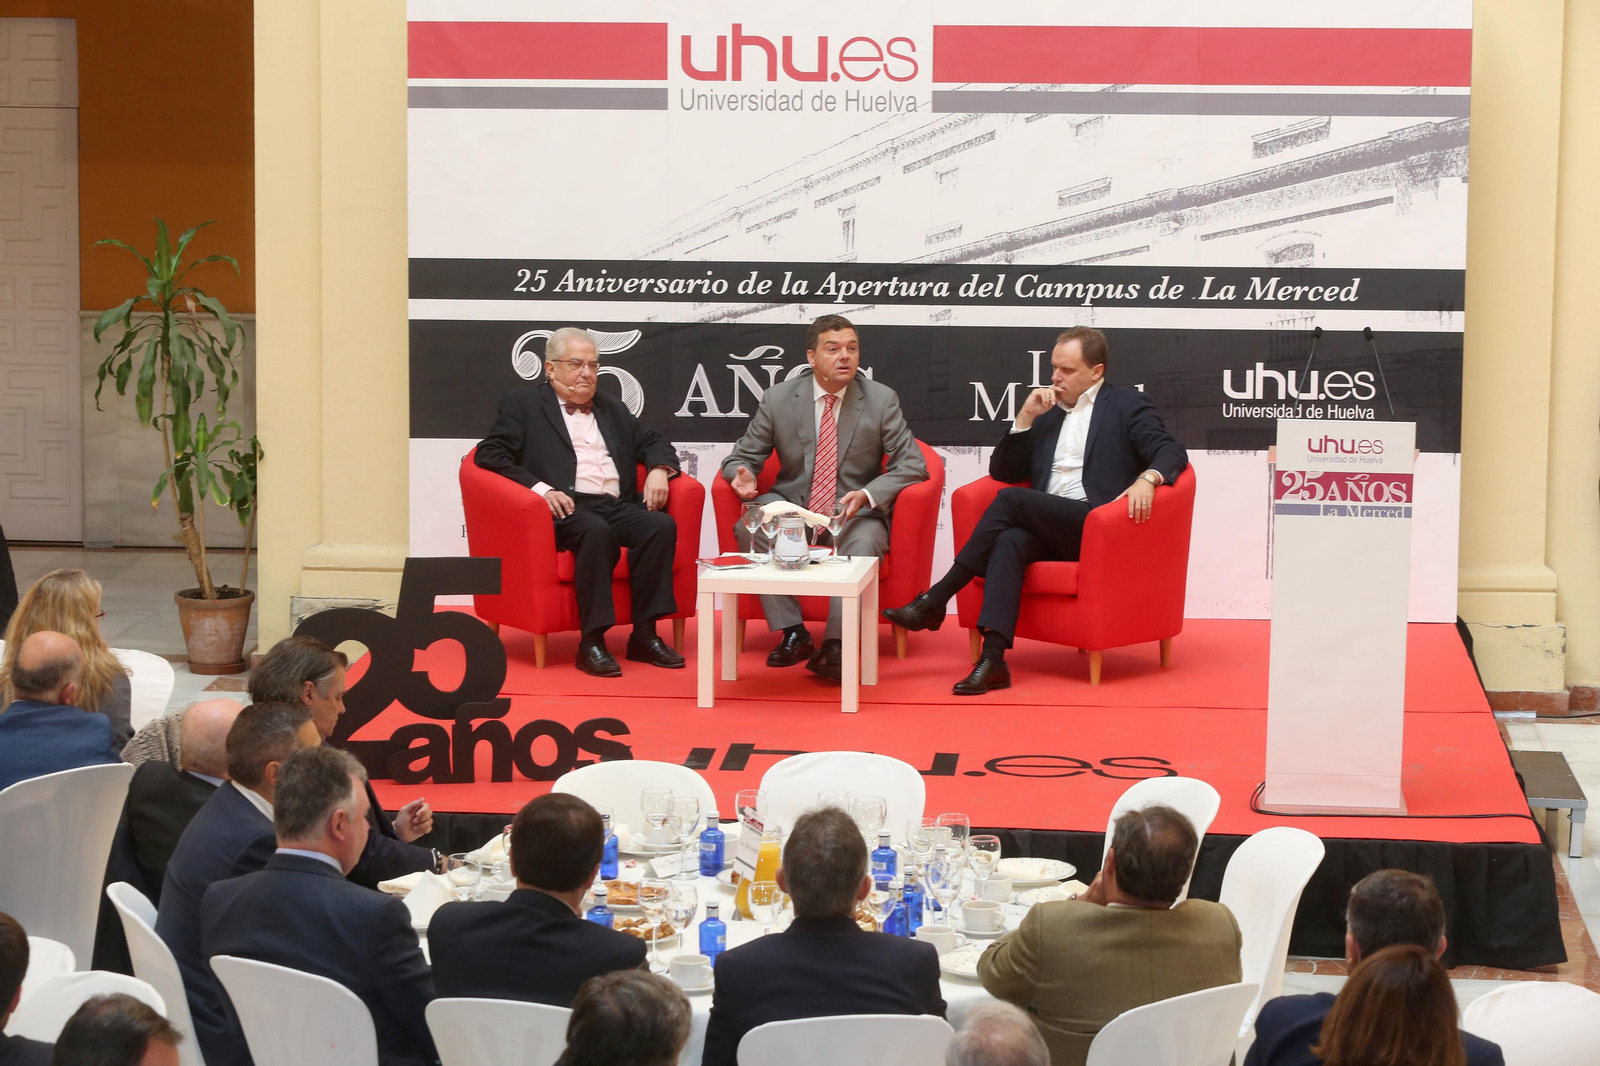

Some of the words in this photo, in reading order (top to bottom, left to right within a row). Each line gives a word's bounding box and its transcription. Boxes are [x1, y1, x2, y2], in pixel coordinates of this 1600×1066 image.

[681, 23, 919, 82] uhu.es
[680, 88, 803, 112] Universidad
[811, 89, 836, 112] de
[845, 90, 918, 113] Huelva
[513, 268, 548, 293] 25
[554, 268, 729, 295] Aniversario
[737, 270, 771, 296] de
[781, 271, 809, 296] la
[815, 271, 950, 303] Apertura
[958, 273, 1004, 298] del
[1014, 273, 1140, 305] Campus
[1149, 275, 1184, 300] de
[1199, 276, 1237, 301] La
[1243, 277, 1361, 302] Merced
[1223, 362, 1376, 400] uhu.es
[1222, 403, 1302, 418] Universidad
[1306, 404, 1323, 419] de
[1327, 404, 1375, 419] Huelva
[1307, 435, 1384, 454] uhu.es
[1307, 454, 1347, 464] Universidad
[1348, 455, 1357, 463] de
[1359, 455, 1383, 464] Huelva
[1281, 471, 1324, 501] 25
[1325, 473, 1407, 503] AÑOS
[1346, 505, 1405, 518] Merced
[291, 557, 507, 781] 25
[388, 698, 634, 785] años
